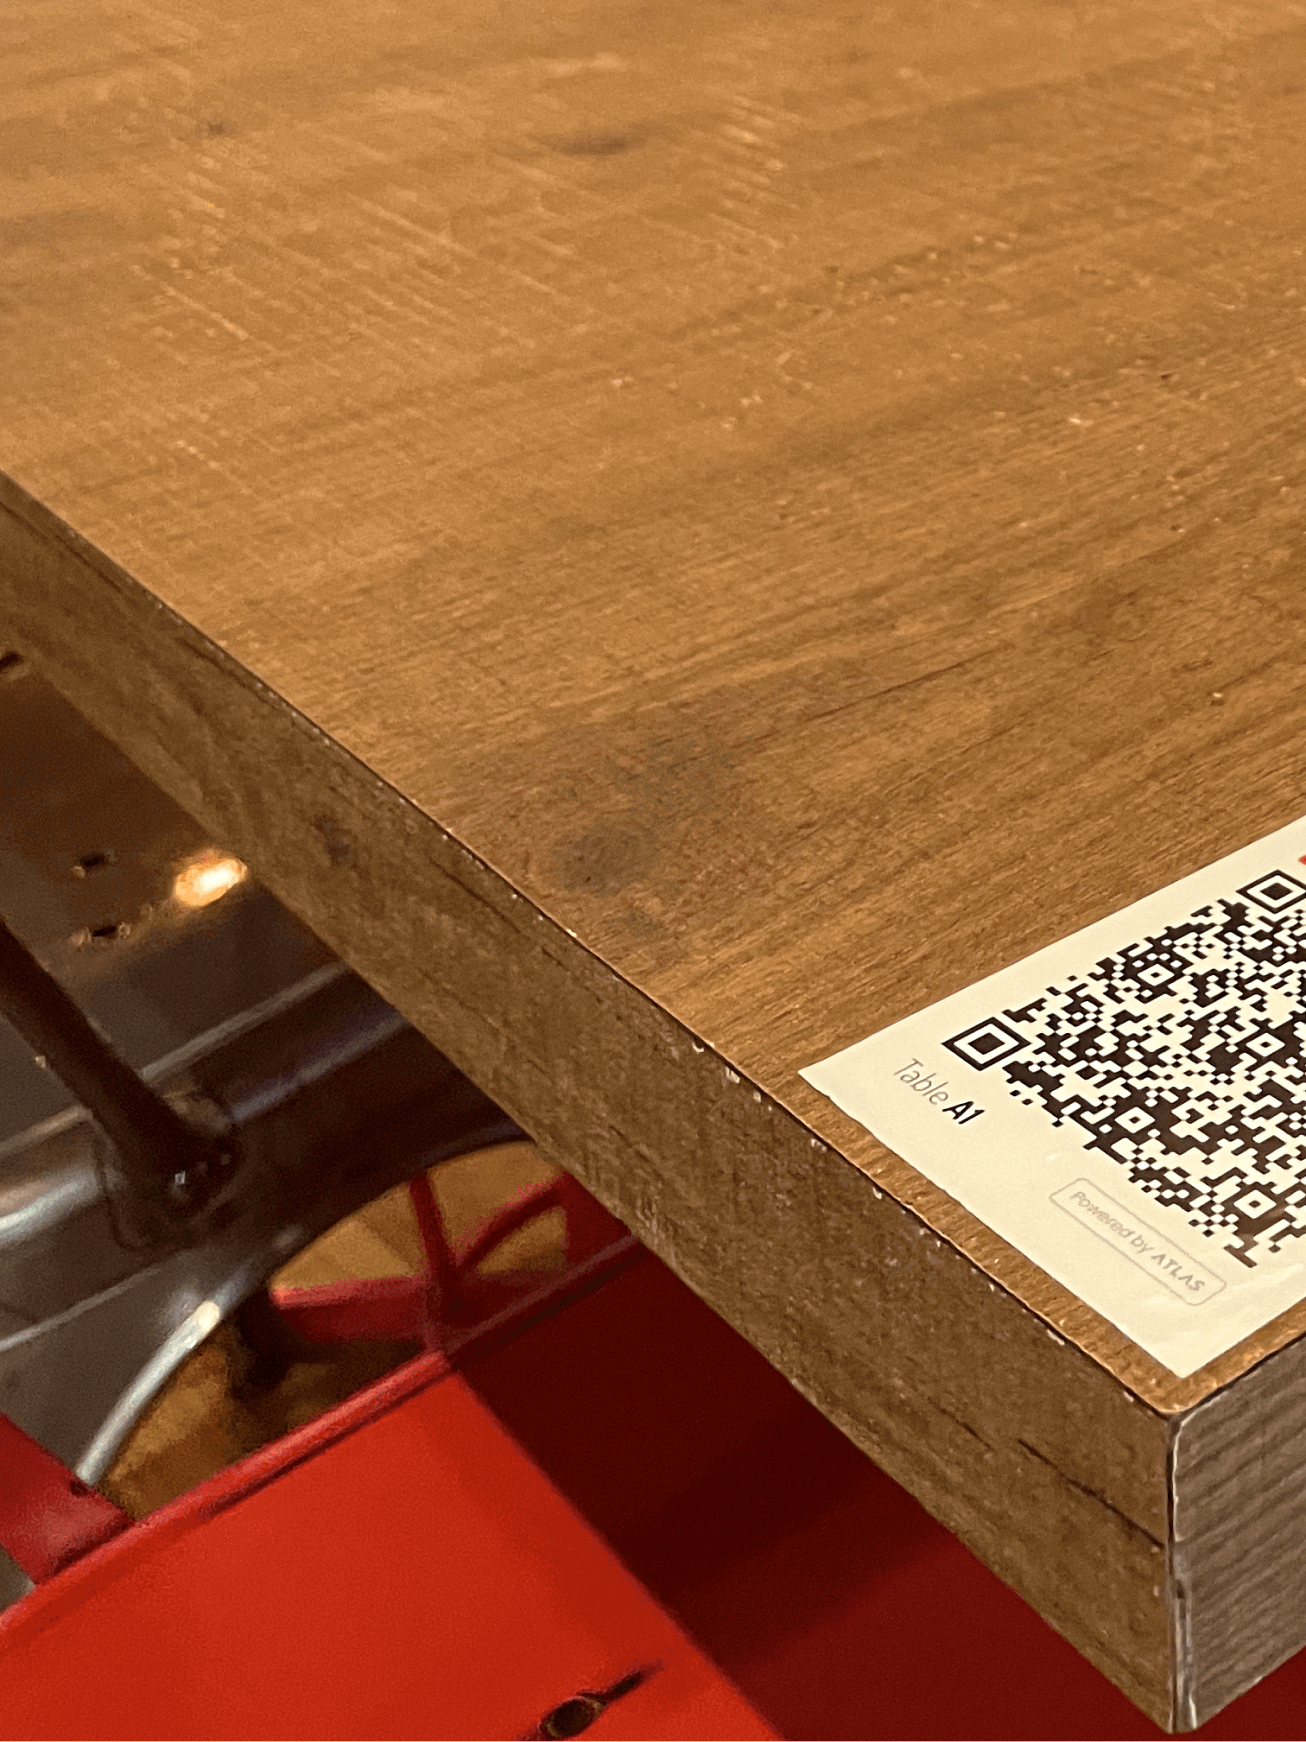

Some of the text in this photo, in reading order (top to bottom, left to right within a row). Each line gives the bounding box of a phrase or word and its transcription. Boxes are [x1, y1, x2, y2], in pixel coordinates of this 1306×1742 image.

[893, 1058, 986, 1125] Table A1
[1070, 1191, 1206, 1291] Powered by ATLAS
